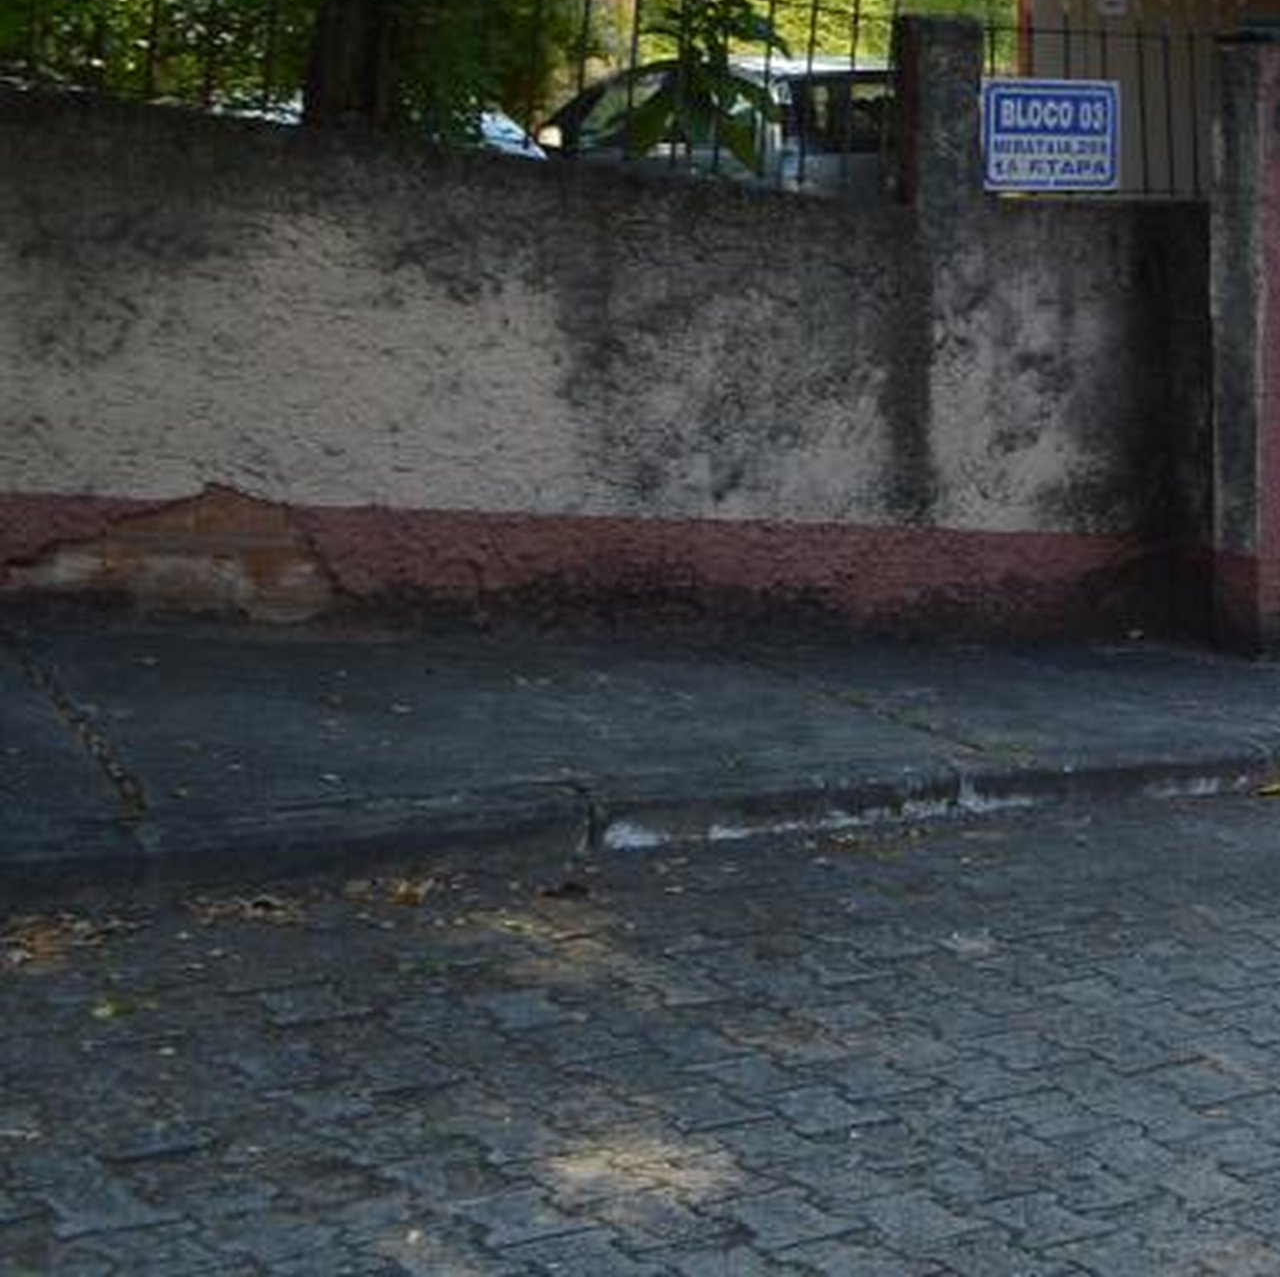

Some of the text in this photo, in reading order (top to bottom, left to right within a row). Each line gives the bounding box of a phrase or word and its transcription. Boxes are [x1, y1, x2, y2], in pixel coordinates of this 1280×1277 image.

[1000, 98, 1106, 130] BLOCO 03
[1029, 159, 1107, 176] ETAPA
